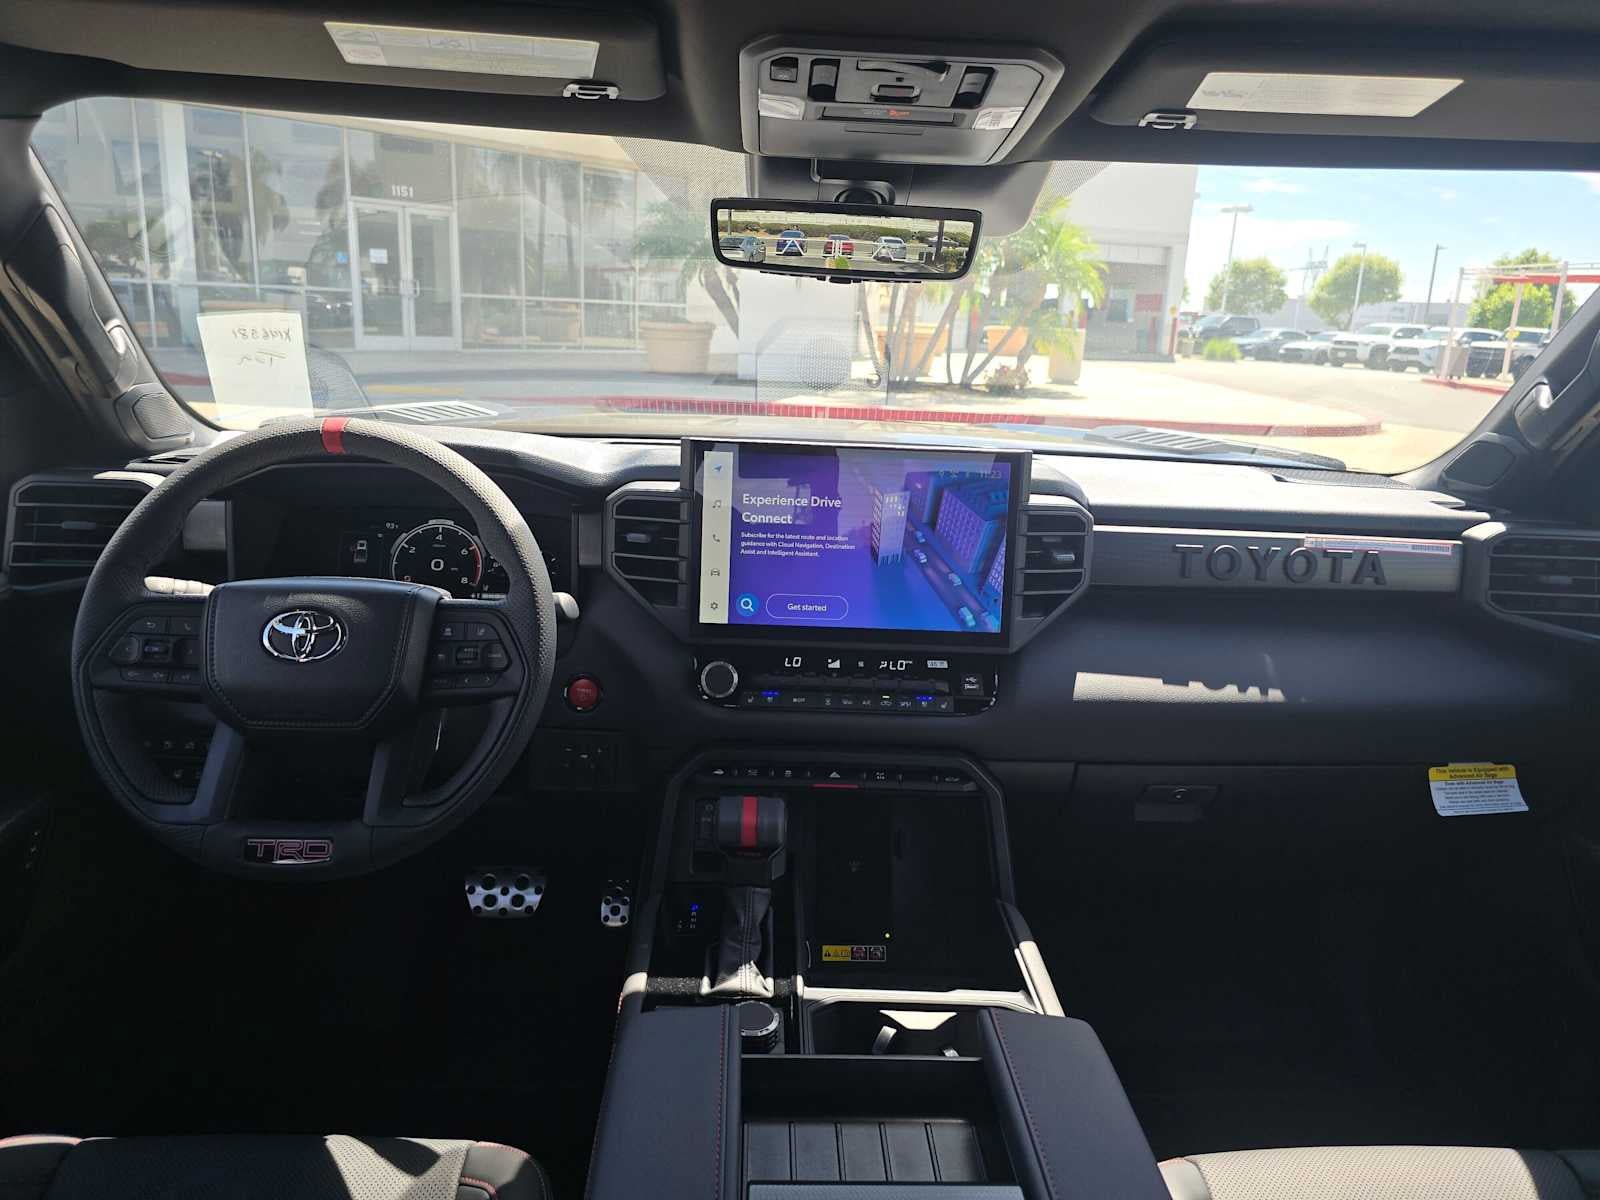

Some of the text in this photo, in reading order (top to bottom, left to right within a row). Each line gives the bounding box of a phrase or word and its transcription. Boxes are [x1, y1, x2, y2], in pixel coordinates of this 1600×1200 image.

[391, 184, 414, 198] 1151
[742, 493, 842, 508] Experience Drive
[741, 511, 793, 524] Connect
[409, 546, 416, 555] 2
[459, 548, 469, 556] 6
[768, 550, 794, 558] Intelligent
[430, 559, 445, 572] 0
[1169, 543, 1387, 585] TOYOTA
[459, 576, 469, 584] 8
[787, 603, 827, 612] Get started
[784, 656, 801, 668] LO
[889, 660, 906, 671] LO
[247, 838, 333, 863] TRD
